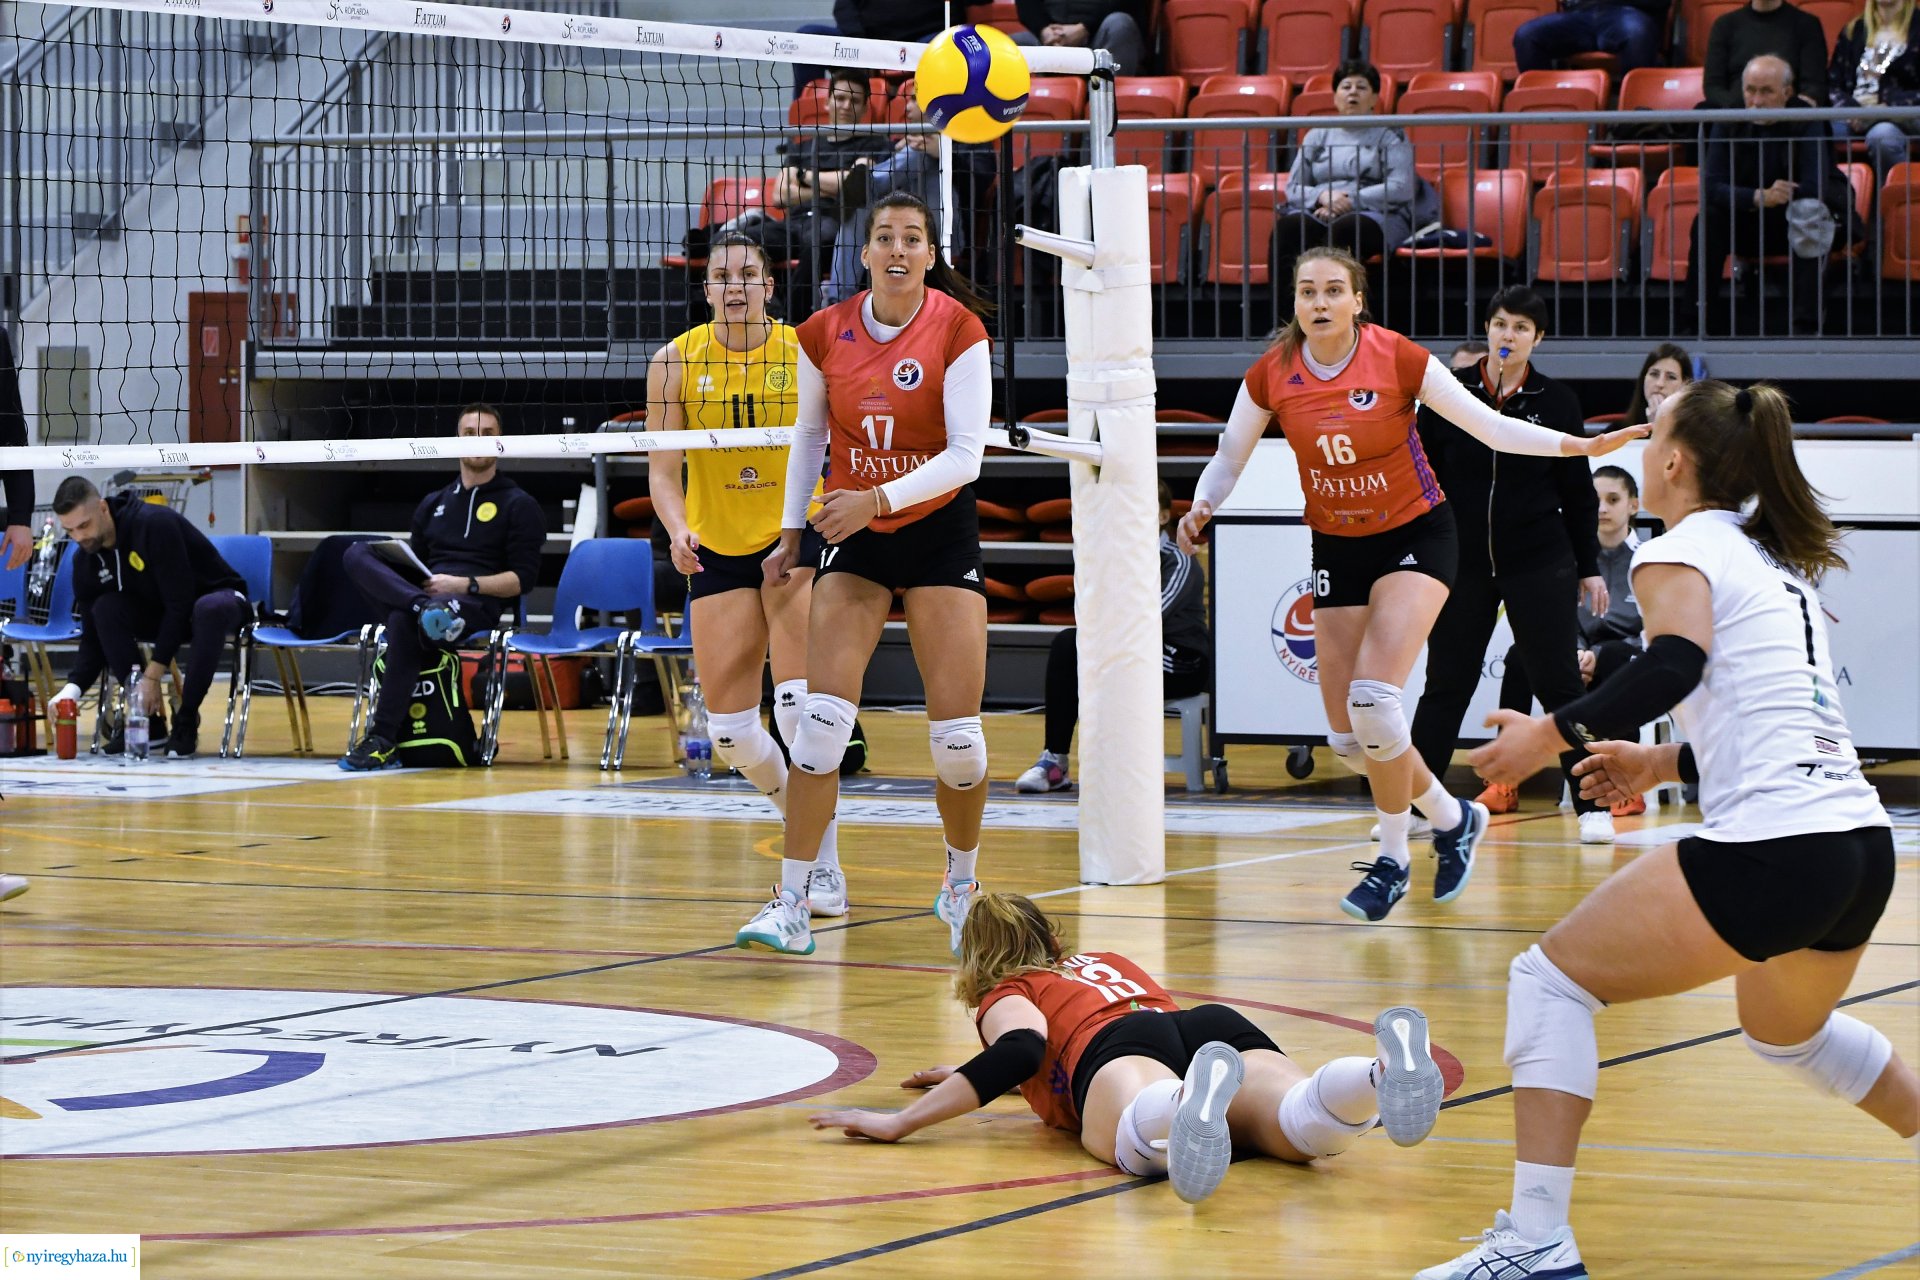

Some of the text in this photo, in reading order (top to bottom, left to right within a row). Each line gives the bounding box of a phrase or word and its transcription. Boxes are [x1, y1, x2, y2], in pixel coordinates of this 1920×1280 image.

[414, 7, 447, 26] FATUM
[636, 26, 664, 44] FATUM
[834, 42, 859, 59] FATUM
[732, 393, 756, 428] 11
[631, 435, 658, 448] FATUM
[861, 415, 894, 450] 17
[158, 448, 190, 463] FATUM
[409, 442, 438, 455] FATUM
[1316, 433, 1357, 466] 16
[849, 447, 929, 474] FATUM
[1309, 468, 1389, 493] FATUM
[1782, 580, 1816, 667] 7
[811, 713, 835, 727] MIKASA
[1075, 962, 1148, 1003] 13
